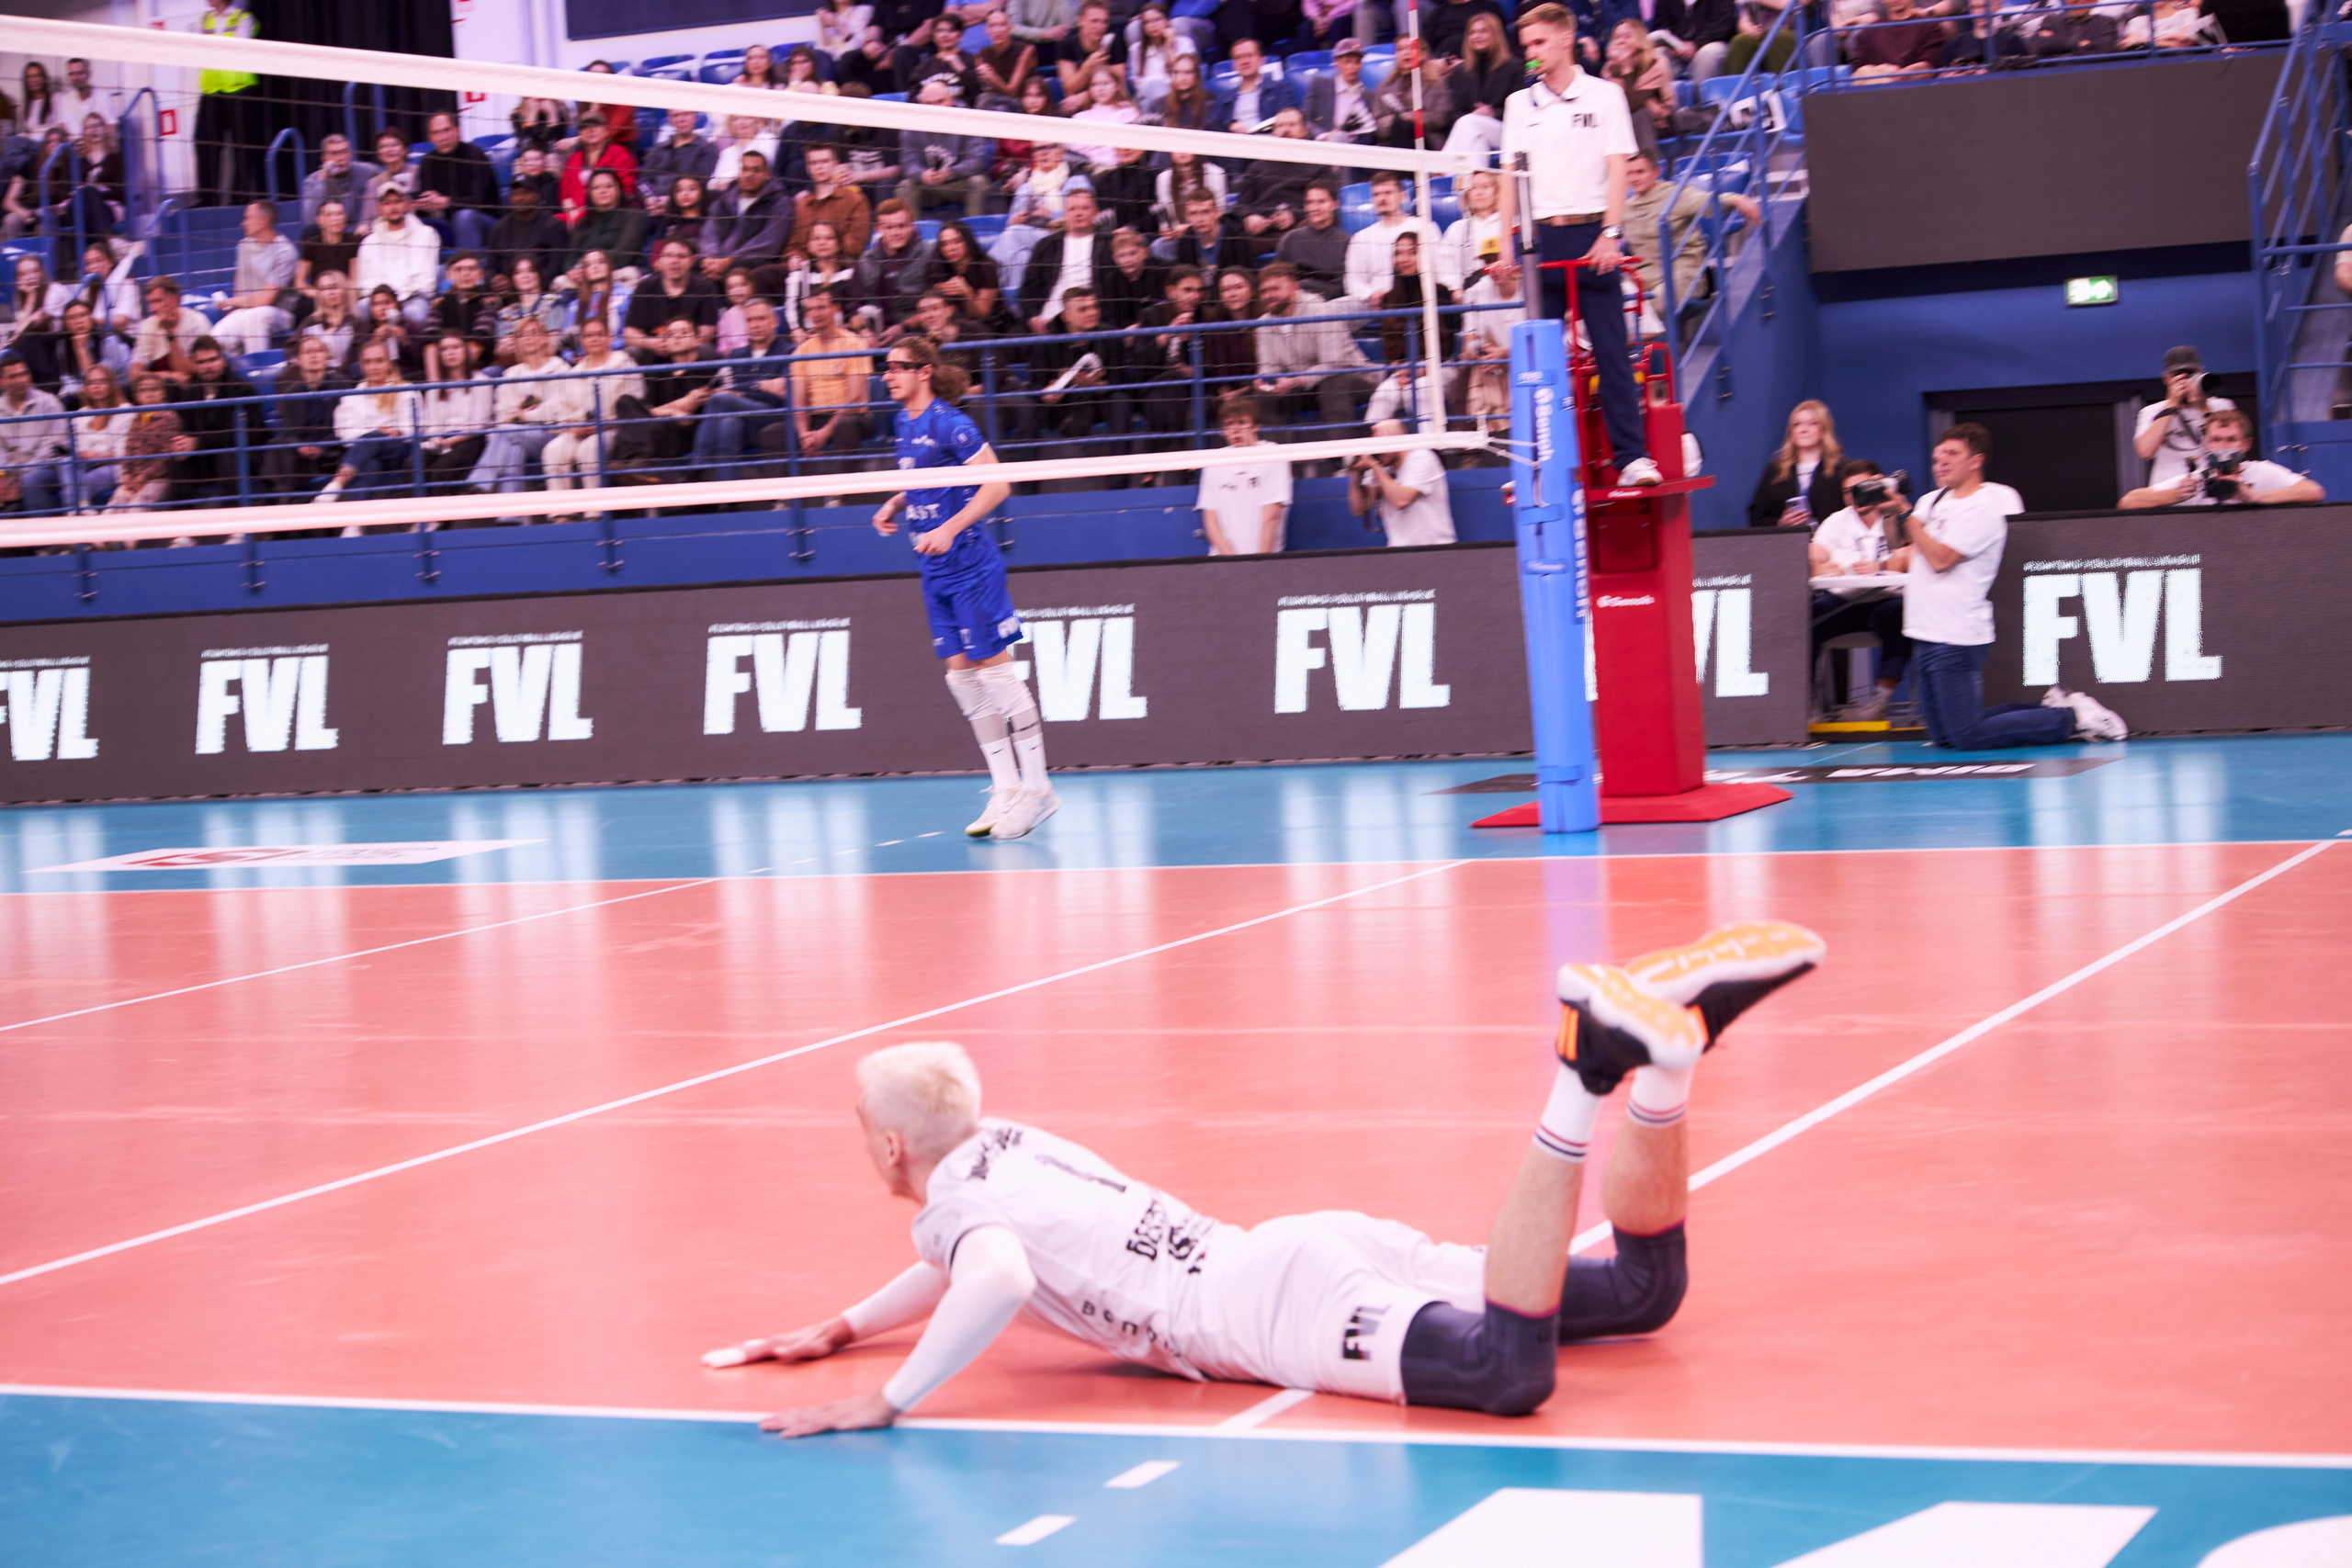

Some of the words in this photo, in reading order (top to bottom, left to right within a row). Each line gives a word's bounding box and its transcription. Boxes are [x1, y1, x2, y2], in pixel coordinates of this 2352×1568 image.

[1274, 603, 1451, 714] FVL
[2023, 568, 2222, 687] FVL
[0, 667, 99, 761] VL
[196, 655, 339, 754] FVL
[443, 642, 594, 745] FVL
[704, 630, 862, 735] FVL
